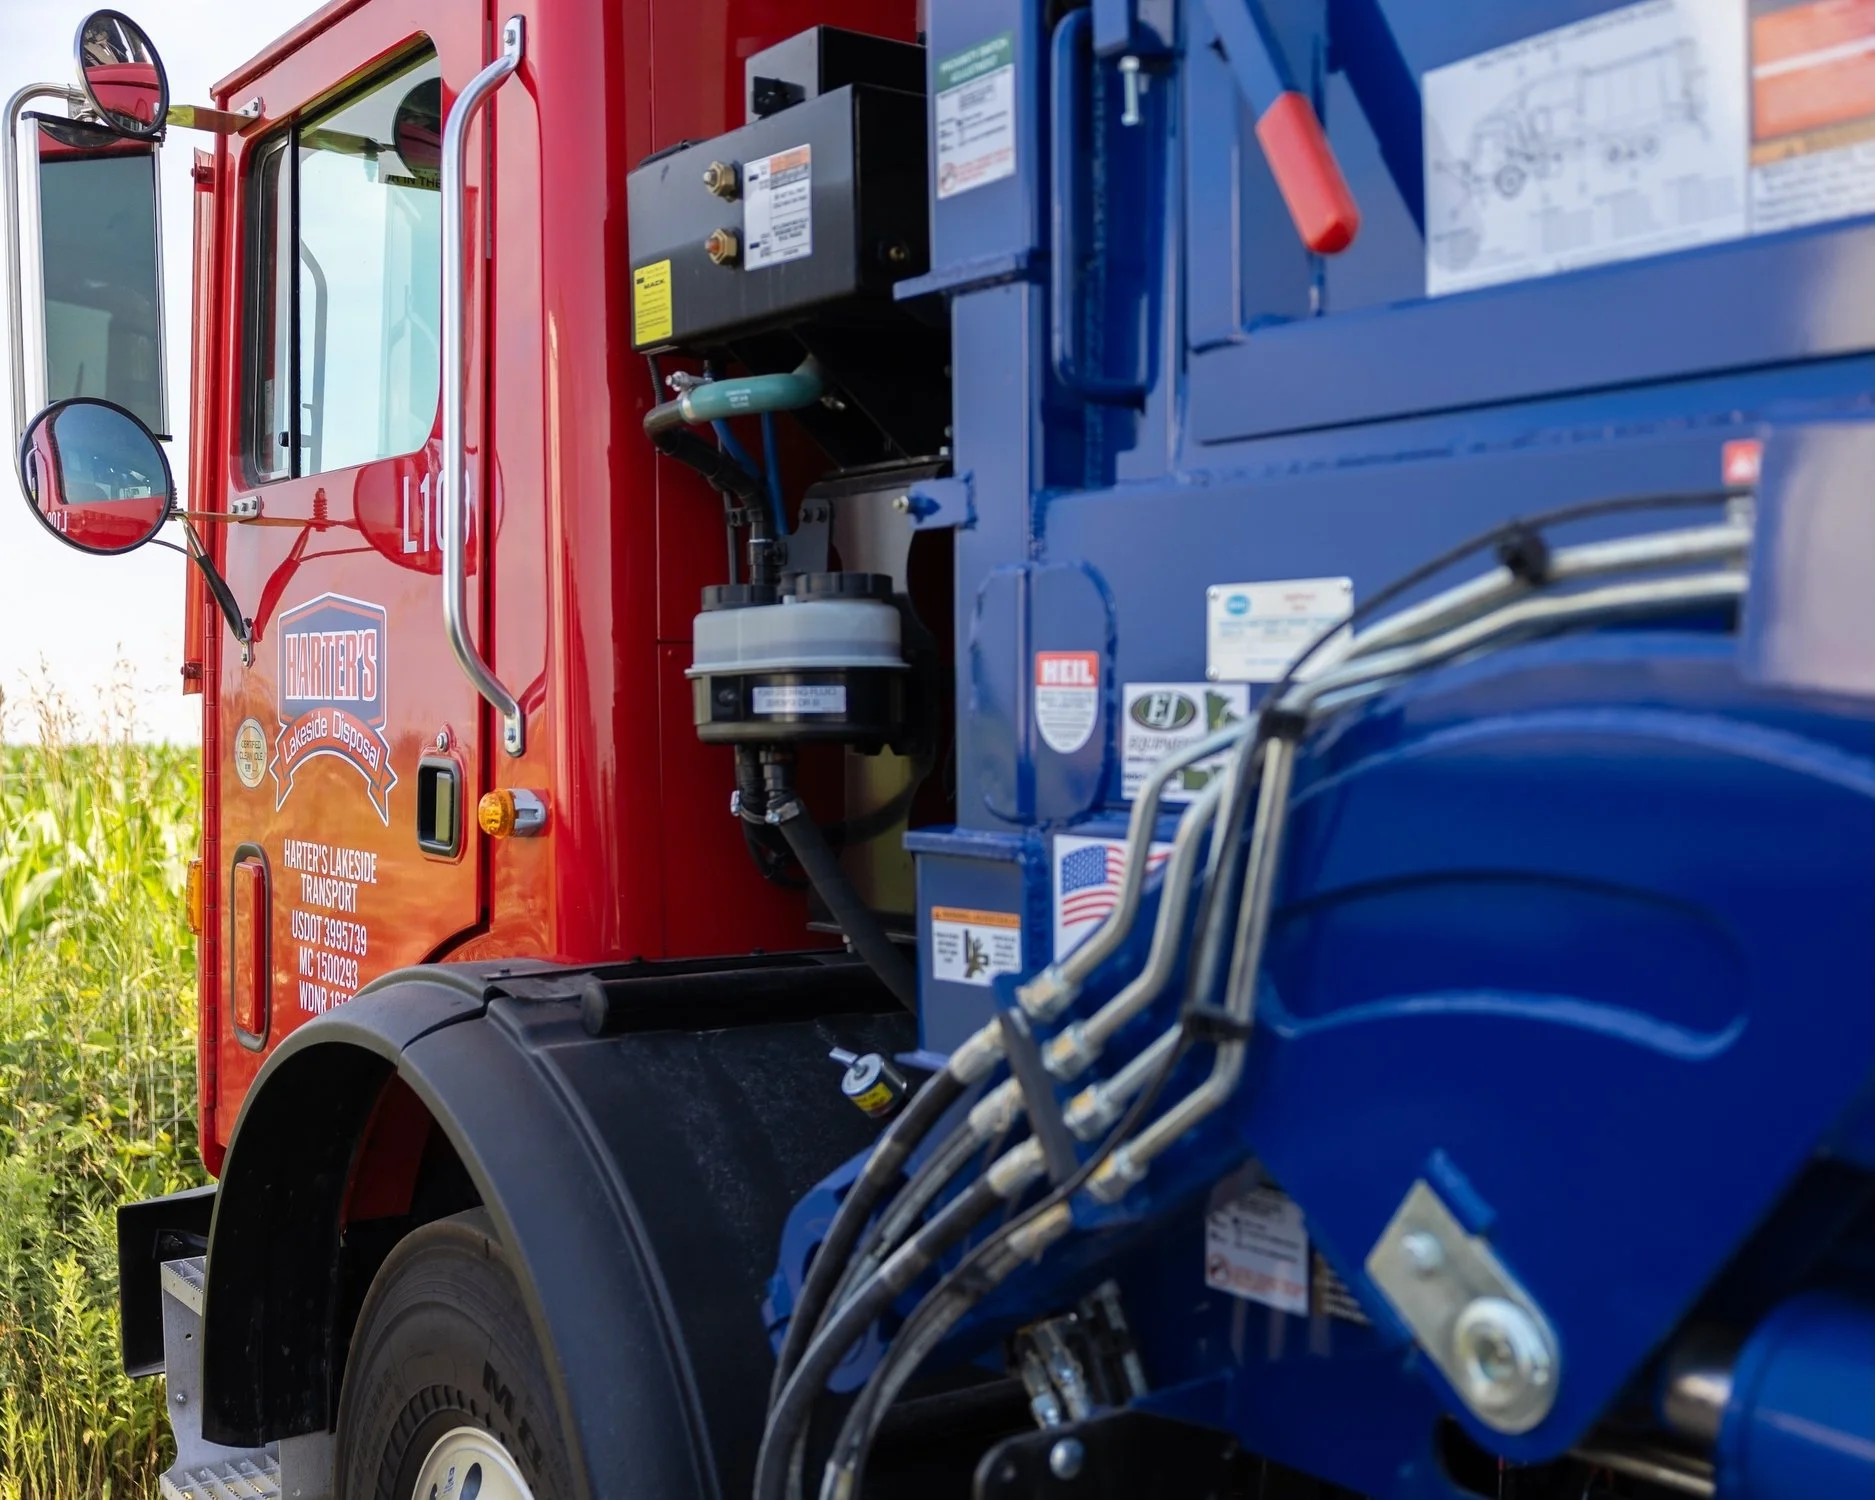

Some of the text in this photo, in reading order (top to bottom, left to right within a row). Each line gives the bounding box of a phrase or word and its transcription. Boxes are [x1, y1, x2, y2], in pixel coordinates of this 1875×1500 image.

[403, 469, 470, 553] L10
[285, 628, 377, 701] HARTER'S
[283, 711, 380, 772] Lakeside Disposal
[284, 839, 377, 884] HARTER'S LAKESIDE
[301, 873, 358, 913] TRANSPORT
[292, 910, 367, 956] USDOT 3995739
[299, 946, 358, 991] MC 1500293
[299, 979, 353, 1015] WDNR 16
